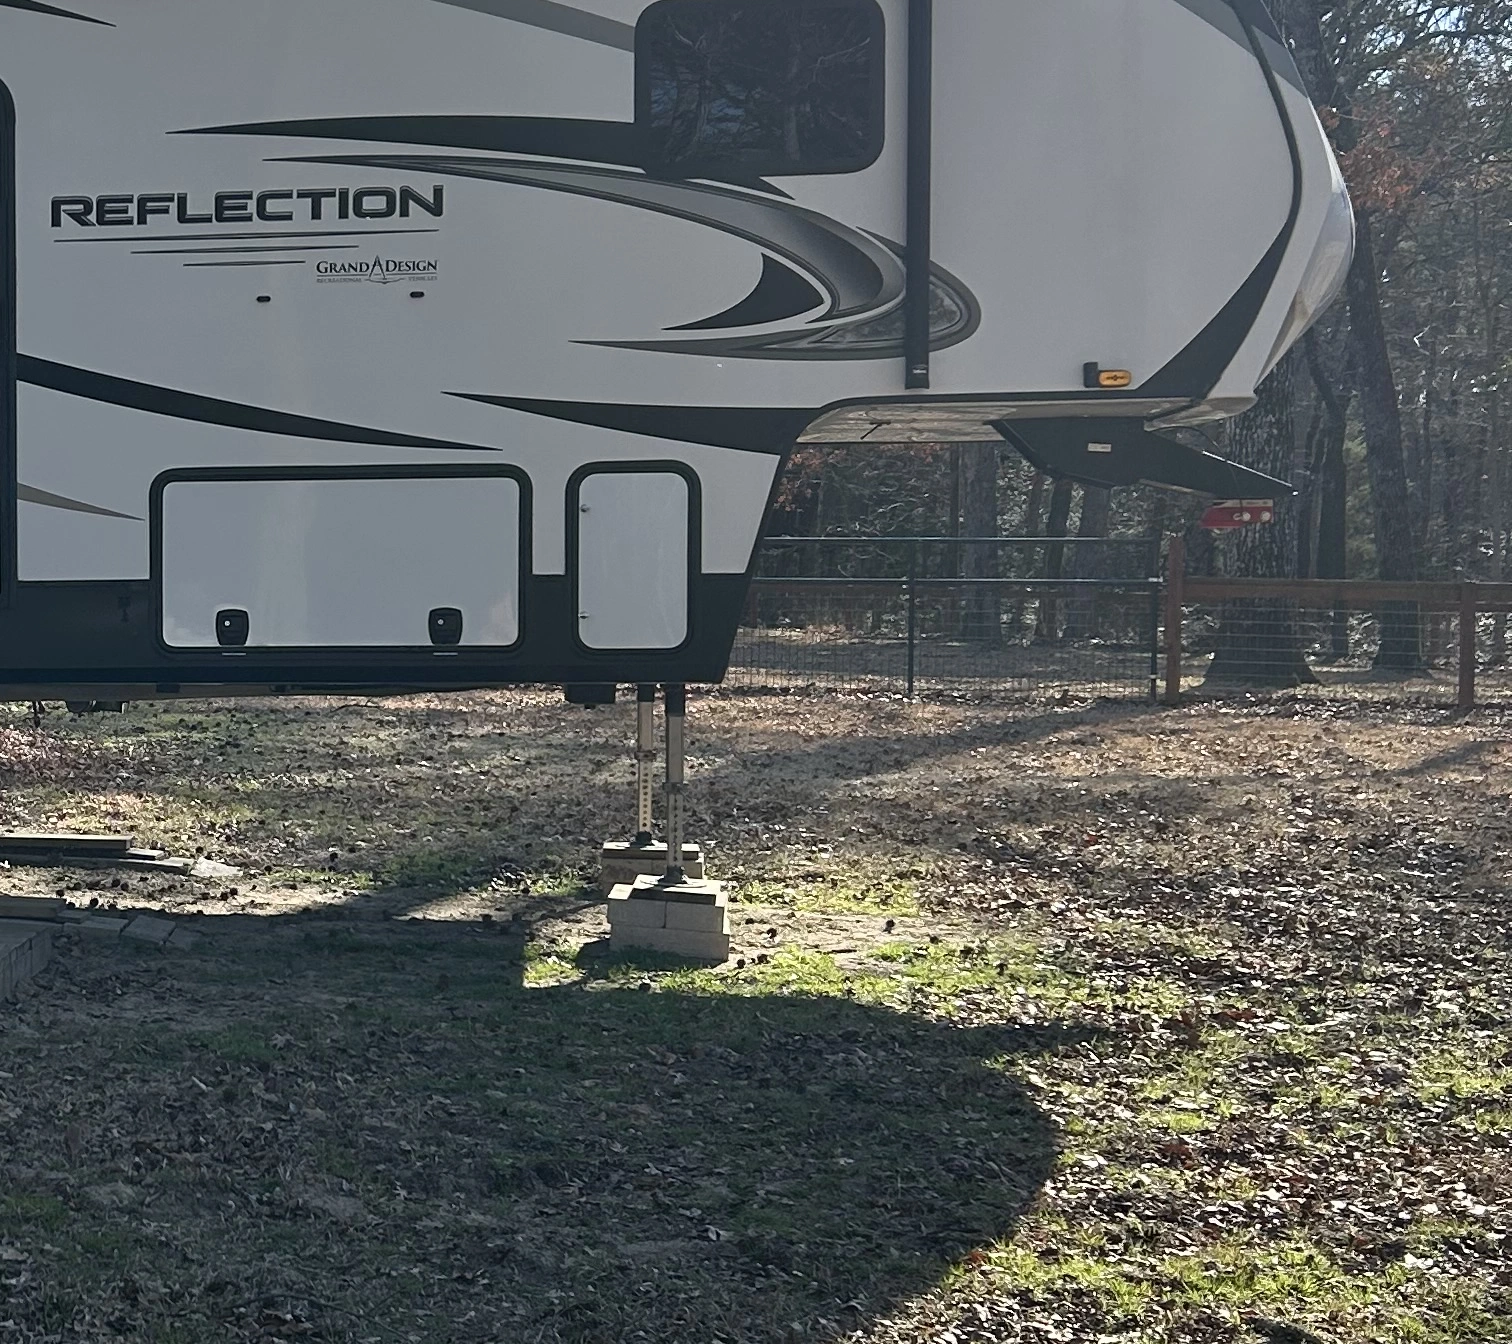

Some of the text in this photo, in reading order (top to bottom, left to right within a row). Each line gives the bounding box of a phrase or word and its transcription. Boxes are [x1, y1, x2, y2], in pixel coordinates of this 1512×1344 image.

[50, 184, 445, 228] REFLECTION
[316, 259, 438, 274] GRAND DESIGN
